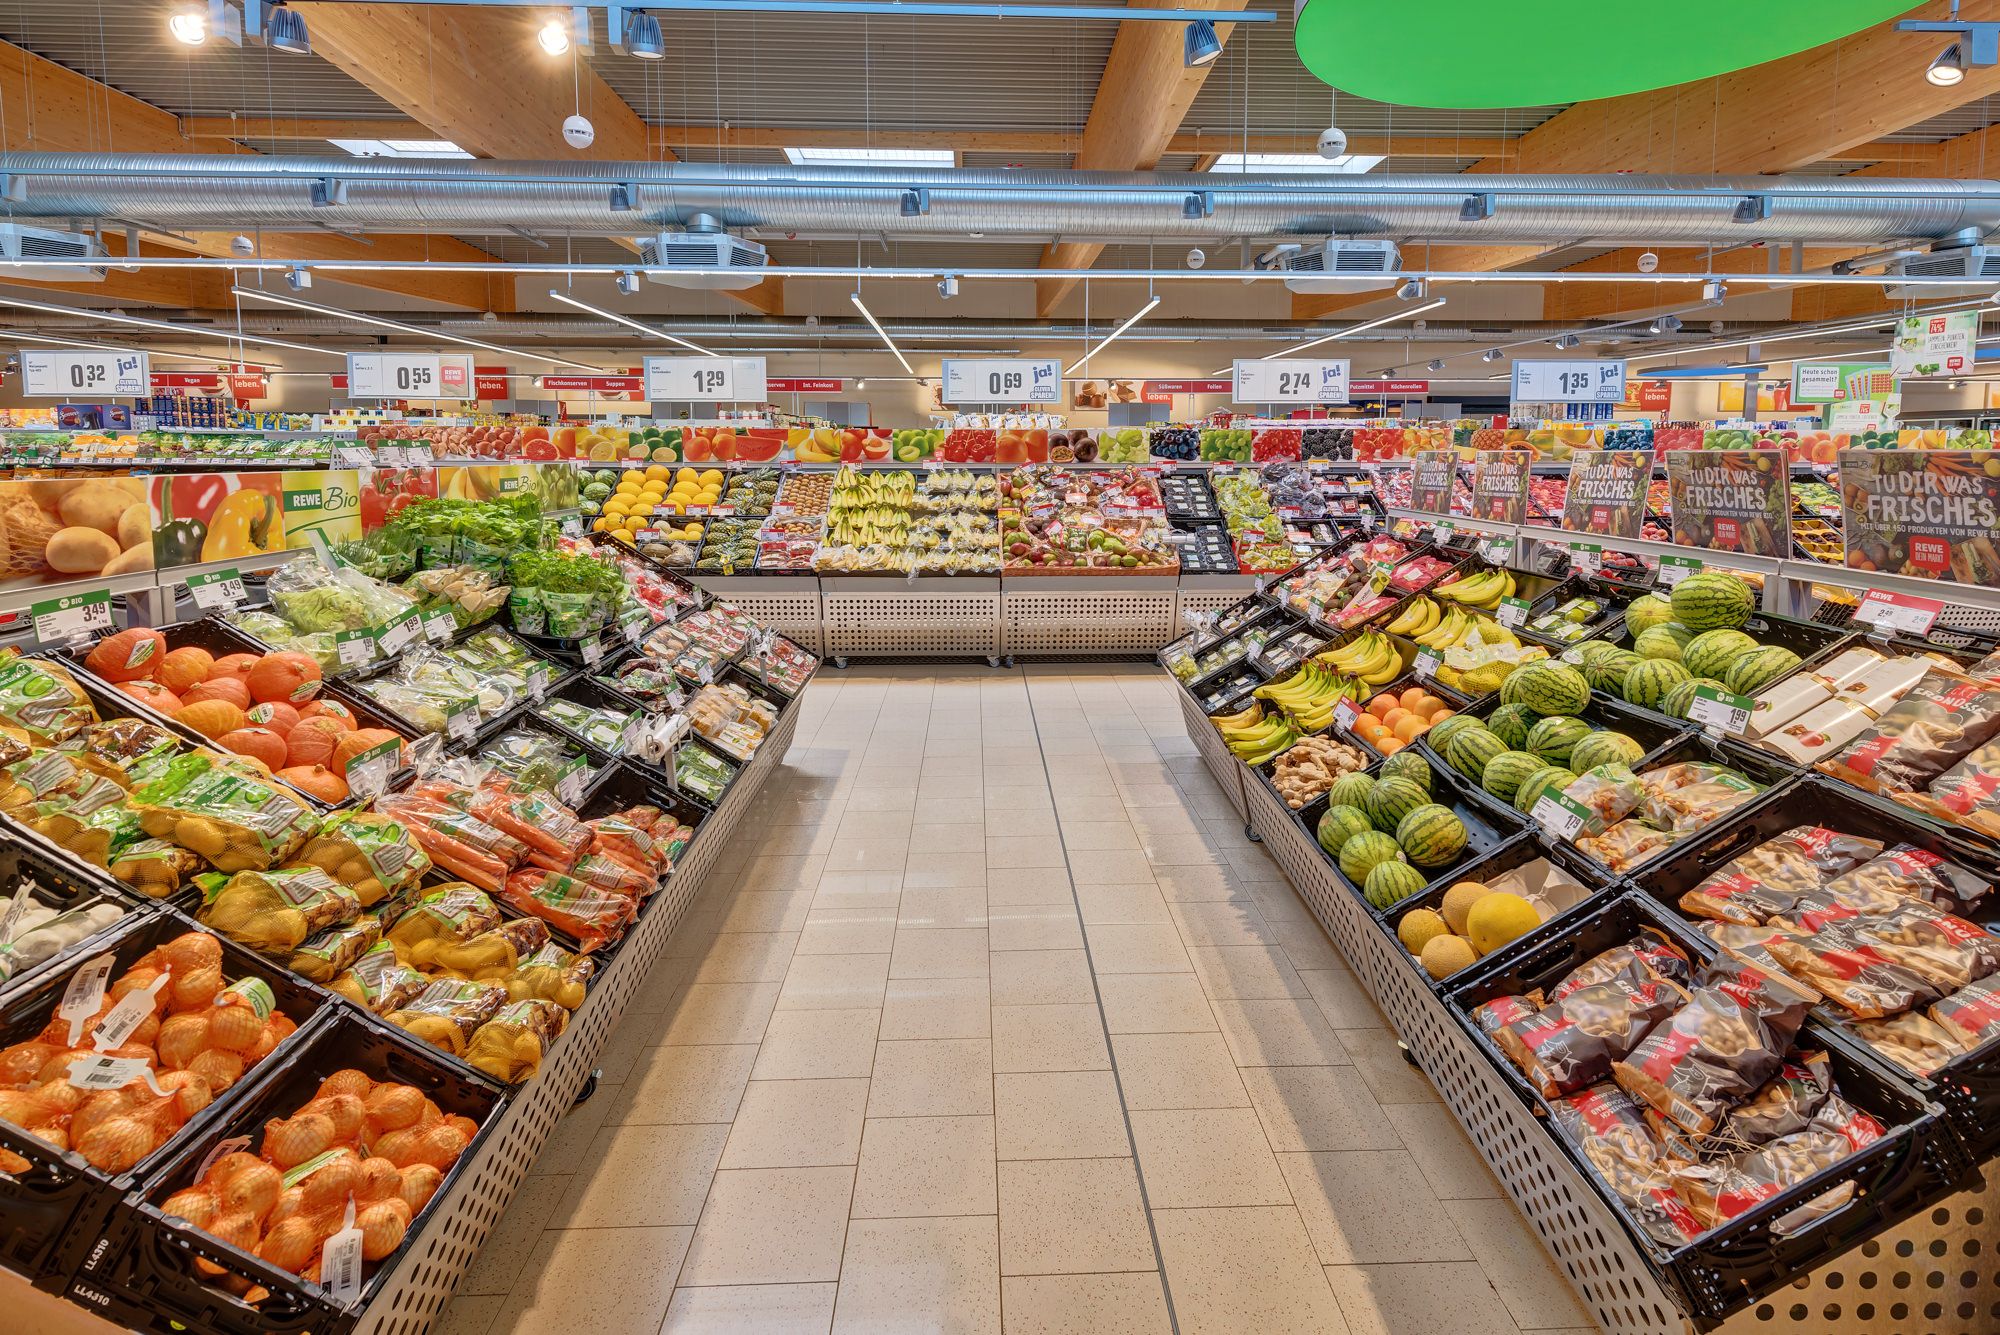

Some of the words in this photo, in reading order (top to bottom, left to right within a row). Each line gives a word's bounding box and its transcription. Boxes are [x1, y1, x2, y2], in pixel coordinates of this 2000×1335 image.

[116, 356, 138, 376] ja!
[1032, 364, 1053, 384] ja!
[1321, 364, 1341, 384] ja!
[1599, 364, 1619, 384] ja!
[70, 364, 105, 387] 0.32
[234, 379, 260, 388] leben.
[396, 366, 432, 390] 0.55
[692, 370, 725, 393] 1.29
[989, 372, 1022, 395] 0.69
[1279, 372, 1311, 395] 2.74
[1559, 372, 1589, 395] 1.35
[1801, 376, 1838, 384] gesammelt?
[479, 381, 504, 391] leben.
[1147, 393, 1171, 401] leben.
[1644, 393, 1668, 401] leben.
[1485, 464, 1493, 475] TU
[1493, 462, 1505, 475] DIR
[1505, 464, 1518, 475] WAS
[1585, 466, 1596, 479] TU
[1596, 464, 1614, 480] DIR
[1616, 466, 1634, 479] WAS
[1688, 470, 1702, 485] TU
[1704, 466, 1730, 486] DIR
[1730, 470, 1758, 485] WAS
[504, 480, 518, 490] REWE
[520, 476, 537, 493] Bio
[1419, 472, 1448, 486] FRISCHES
[1481, 476, 1520, 492] FRISCHES
[1871, 474, 1896, 494] TU
[1898, 470, 1940, 494] DIR
[1940, 475, 1984, 495] WAS
[1578, 480, 1635, 499] FRISCHES
[1686, 485, 1767, 511] FRISCHES
[293, 494, 321, 507] REWE
[324, 486, 358, 511] Bio
[1712, 510, 1738, 518] PRODUKTEN
[1738, 510, 1749, 518] VON
[1867, 494, 1997, 528] FRISCHES
[1717, 522, 1736, 532] REWE
[1874, 522, 1891, 531] ÜBER
[1892, 524, 1906, 533] 450
[1907, 525, 1948, 535] PRODUKTEN
[1950, 527, 1966, 536] VON
[1967, 528, 1988, 538] REWE
[1914, 542, 1944, 554] REWE
[1915, 551, 1926, 561] DEIN
[1926, 552, 1944, 563] MARKT
[220, 579, 242, 598] 3.49
[1870, 591, 1894, 602] REWE
[70, 597, 82, 605] BIO
[82, 602, 106, 622] 3.49
[1877, 608, 1894, 618] 2.49
[403, 616, 419, 633] 1.99
[1730, 707, 1747, 725] 1.99
[372, 748, 381, 756] BIO
[1566, 801, 1576, 809] BIO
[1562, 813, 1581, 830] 1.79
[84, 1238, 110, 1272] LL4310
[74, 1284, 110, 1306] LL4310
